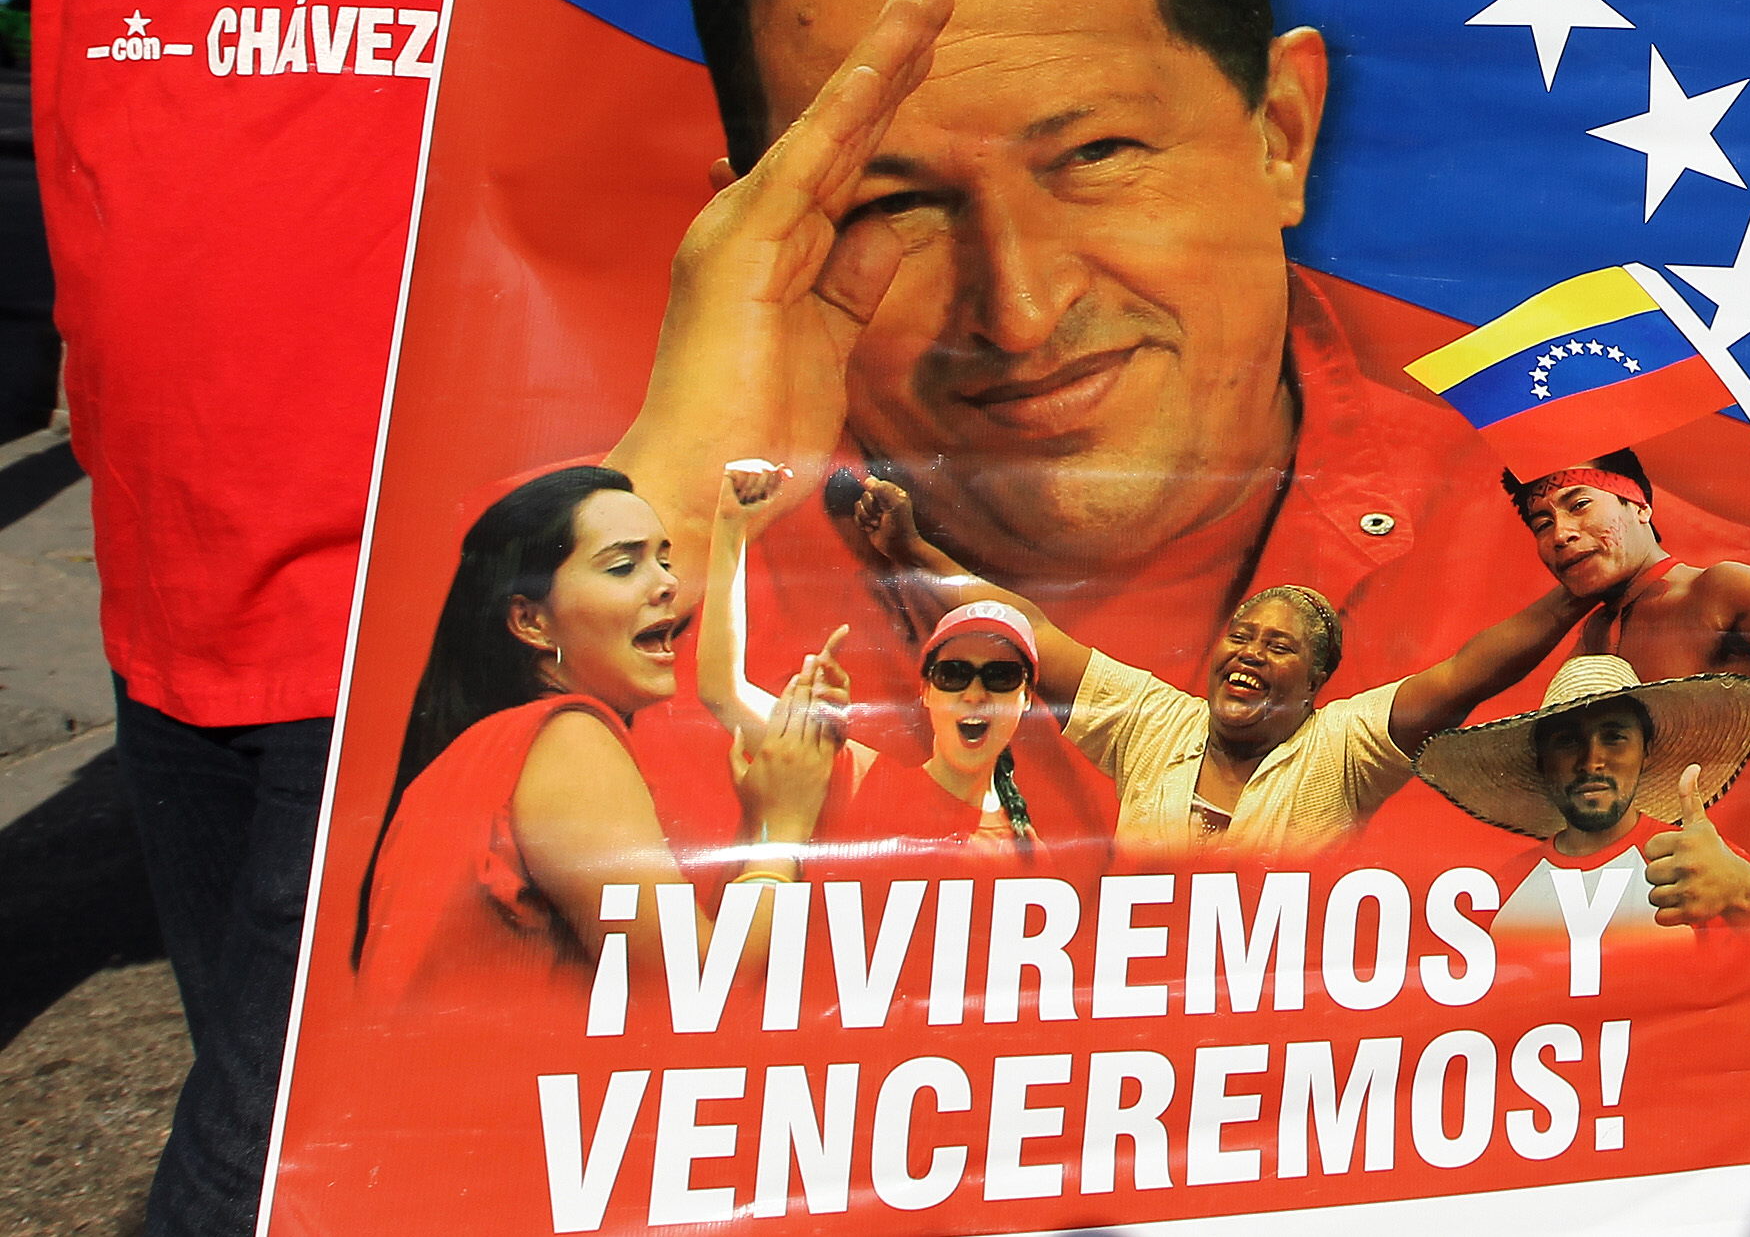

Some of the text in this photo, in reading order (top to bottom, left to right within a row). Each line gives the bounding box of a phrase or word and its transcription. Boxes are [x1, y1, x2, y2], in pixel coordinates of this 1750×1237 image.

[111, 37, 161, 61] con
[585, 866, 1636, 1038] ¡VIVIREMOS Y
[535, 1019, 1633, 1235] VENCEREMOS!
